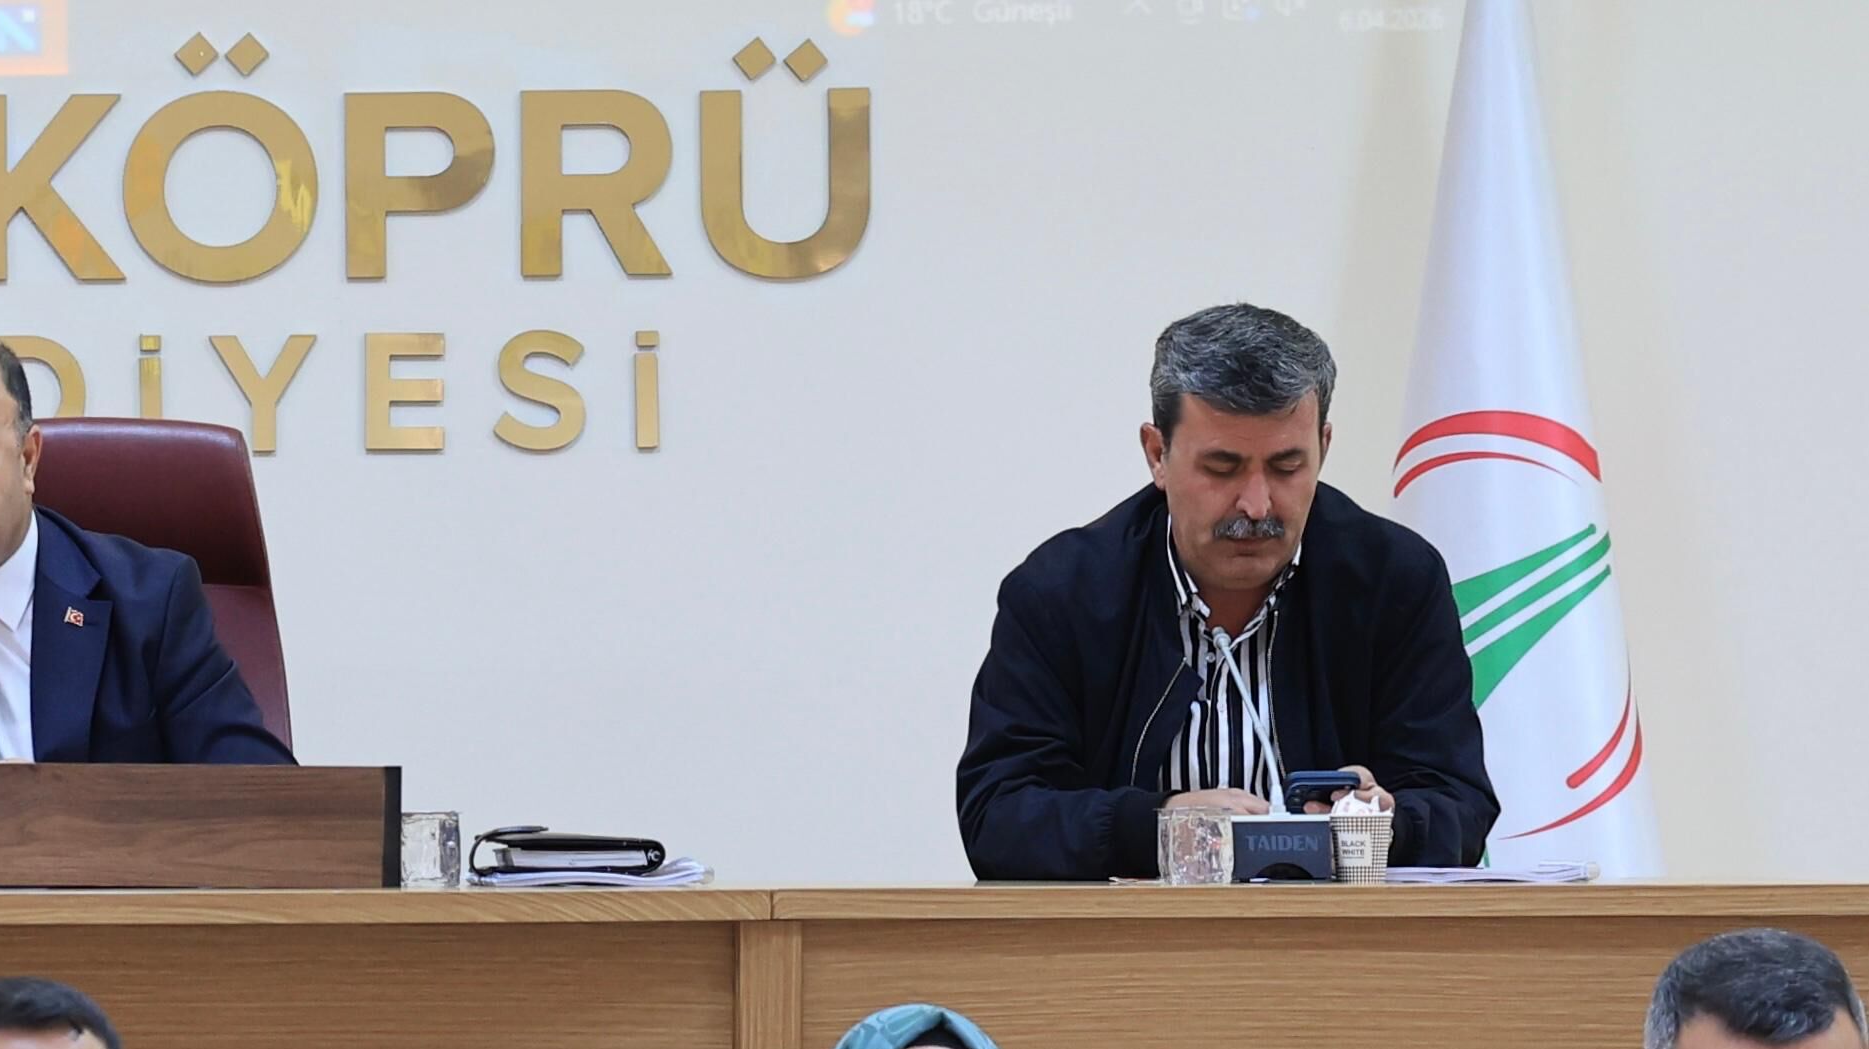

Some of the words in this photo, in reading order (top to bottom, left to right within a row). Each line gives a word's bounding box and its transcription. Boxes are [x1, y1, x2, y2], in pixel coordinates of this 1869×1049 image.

[1244, 834, 1320, 852] TAIDEN
[1340, 840, 1366, 848] BLACK
[1341, 848, 1365, 856] WHITE
